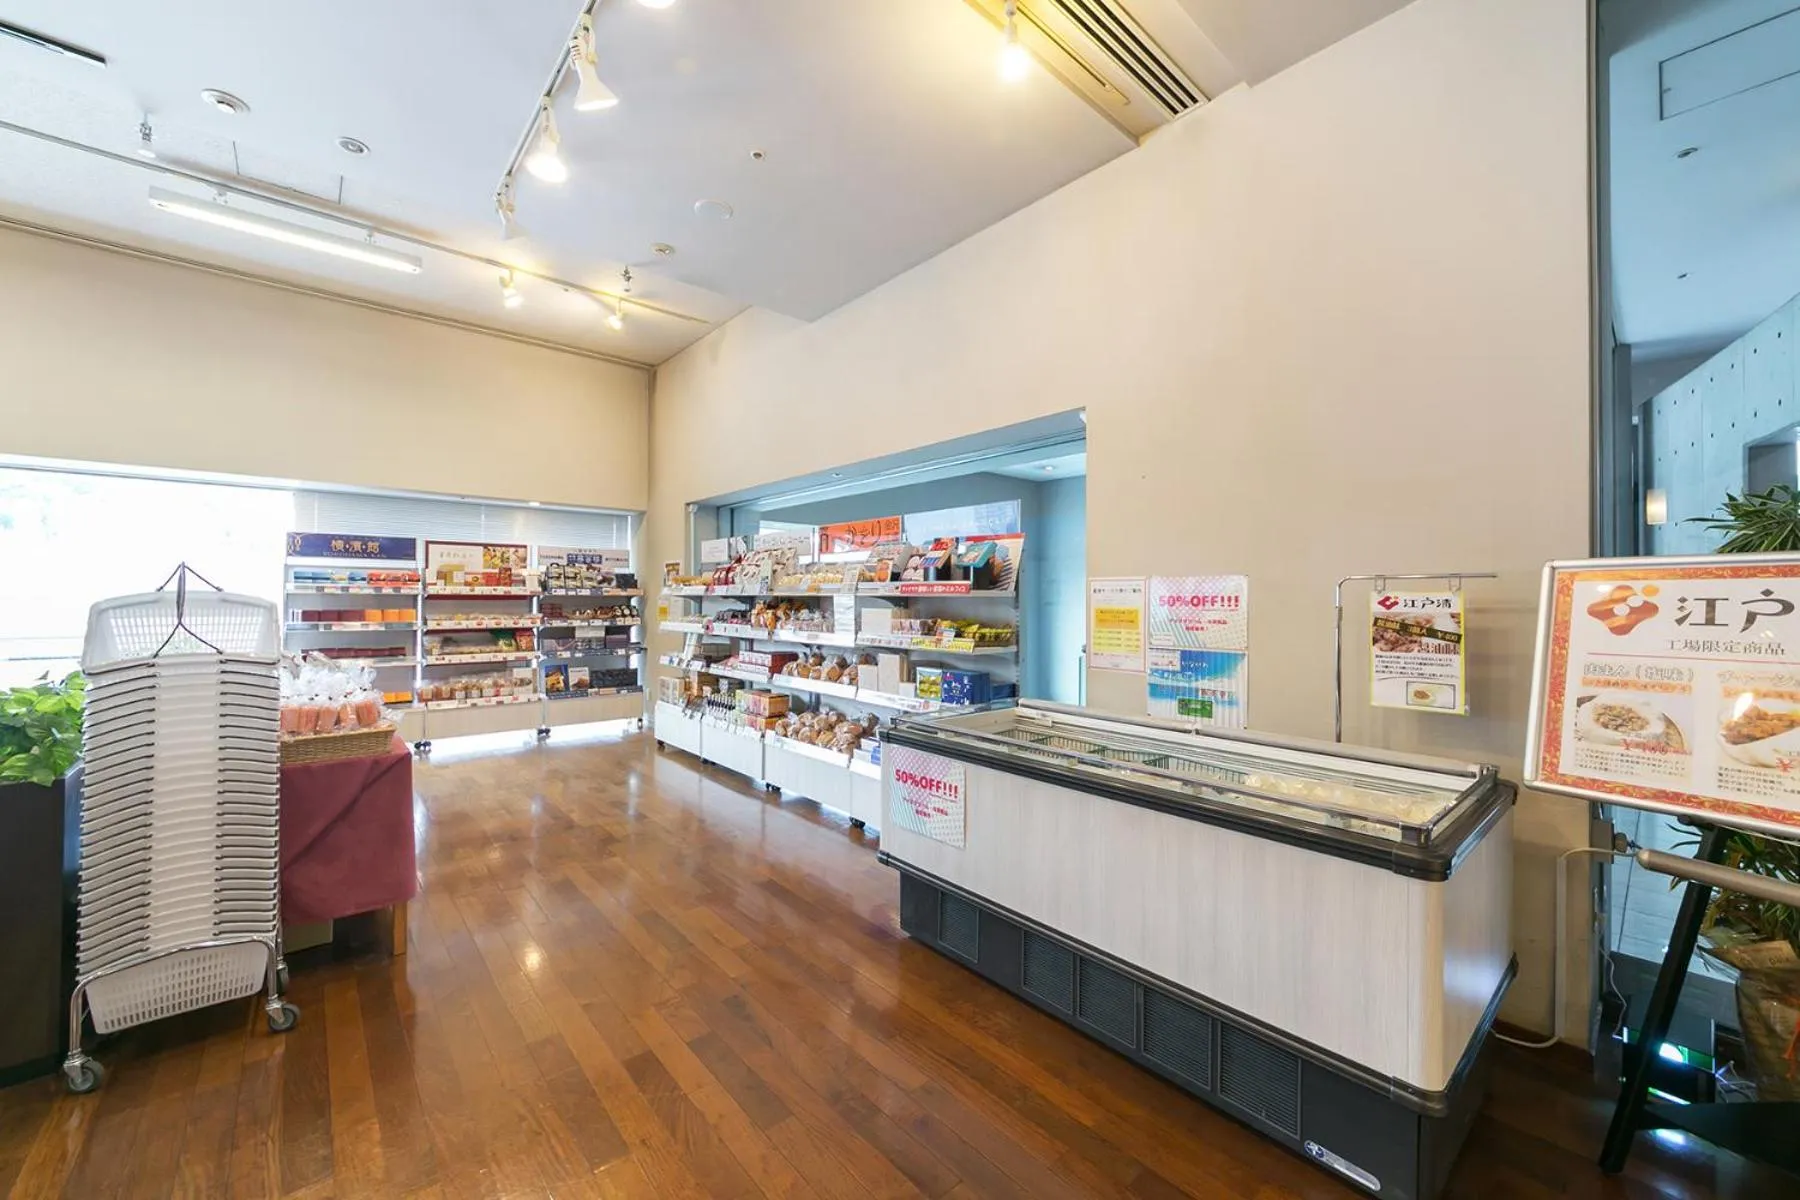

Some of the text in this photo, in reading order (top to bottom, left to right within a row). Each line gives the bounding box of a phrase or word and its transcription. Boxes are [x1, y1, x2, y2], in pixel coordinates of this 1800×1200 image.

[1159, 595, 1240, 608] 50%OFF!!!
[1666, 639, 1787, 657] 工場限定商品
[895, 769, 959, 799] 50%OFF!!!
